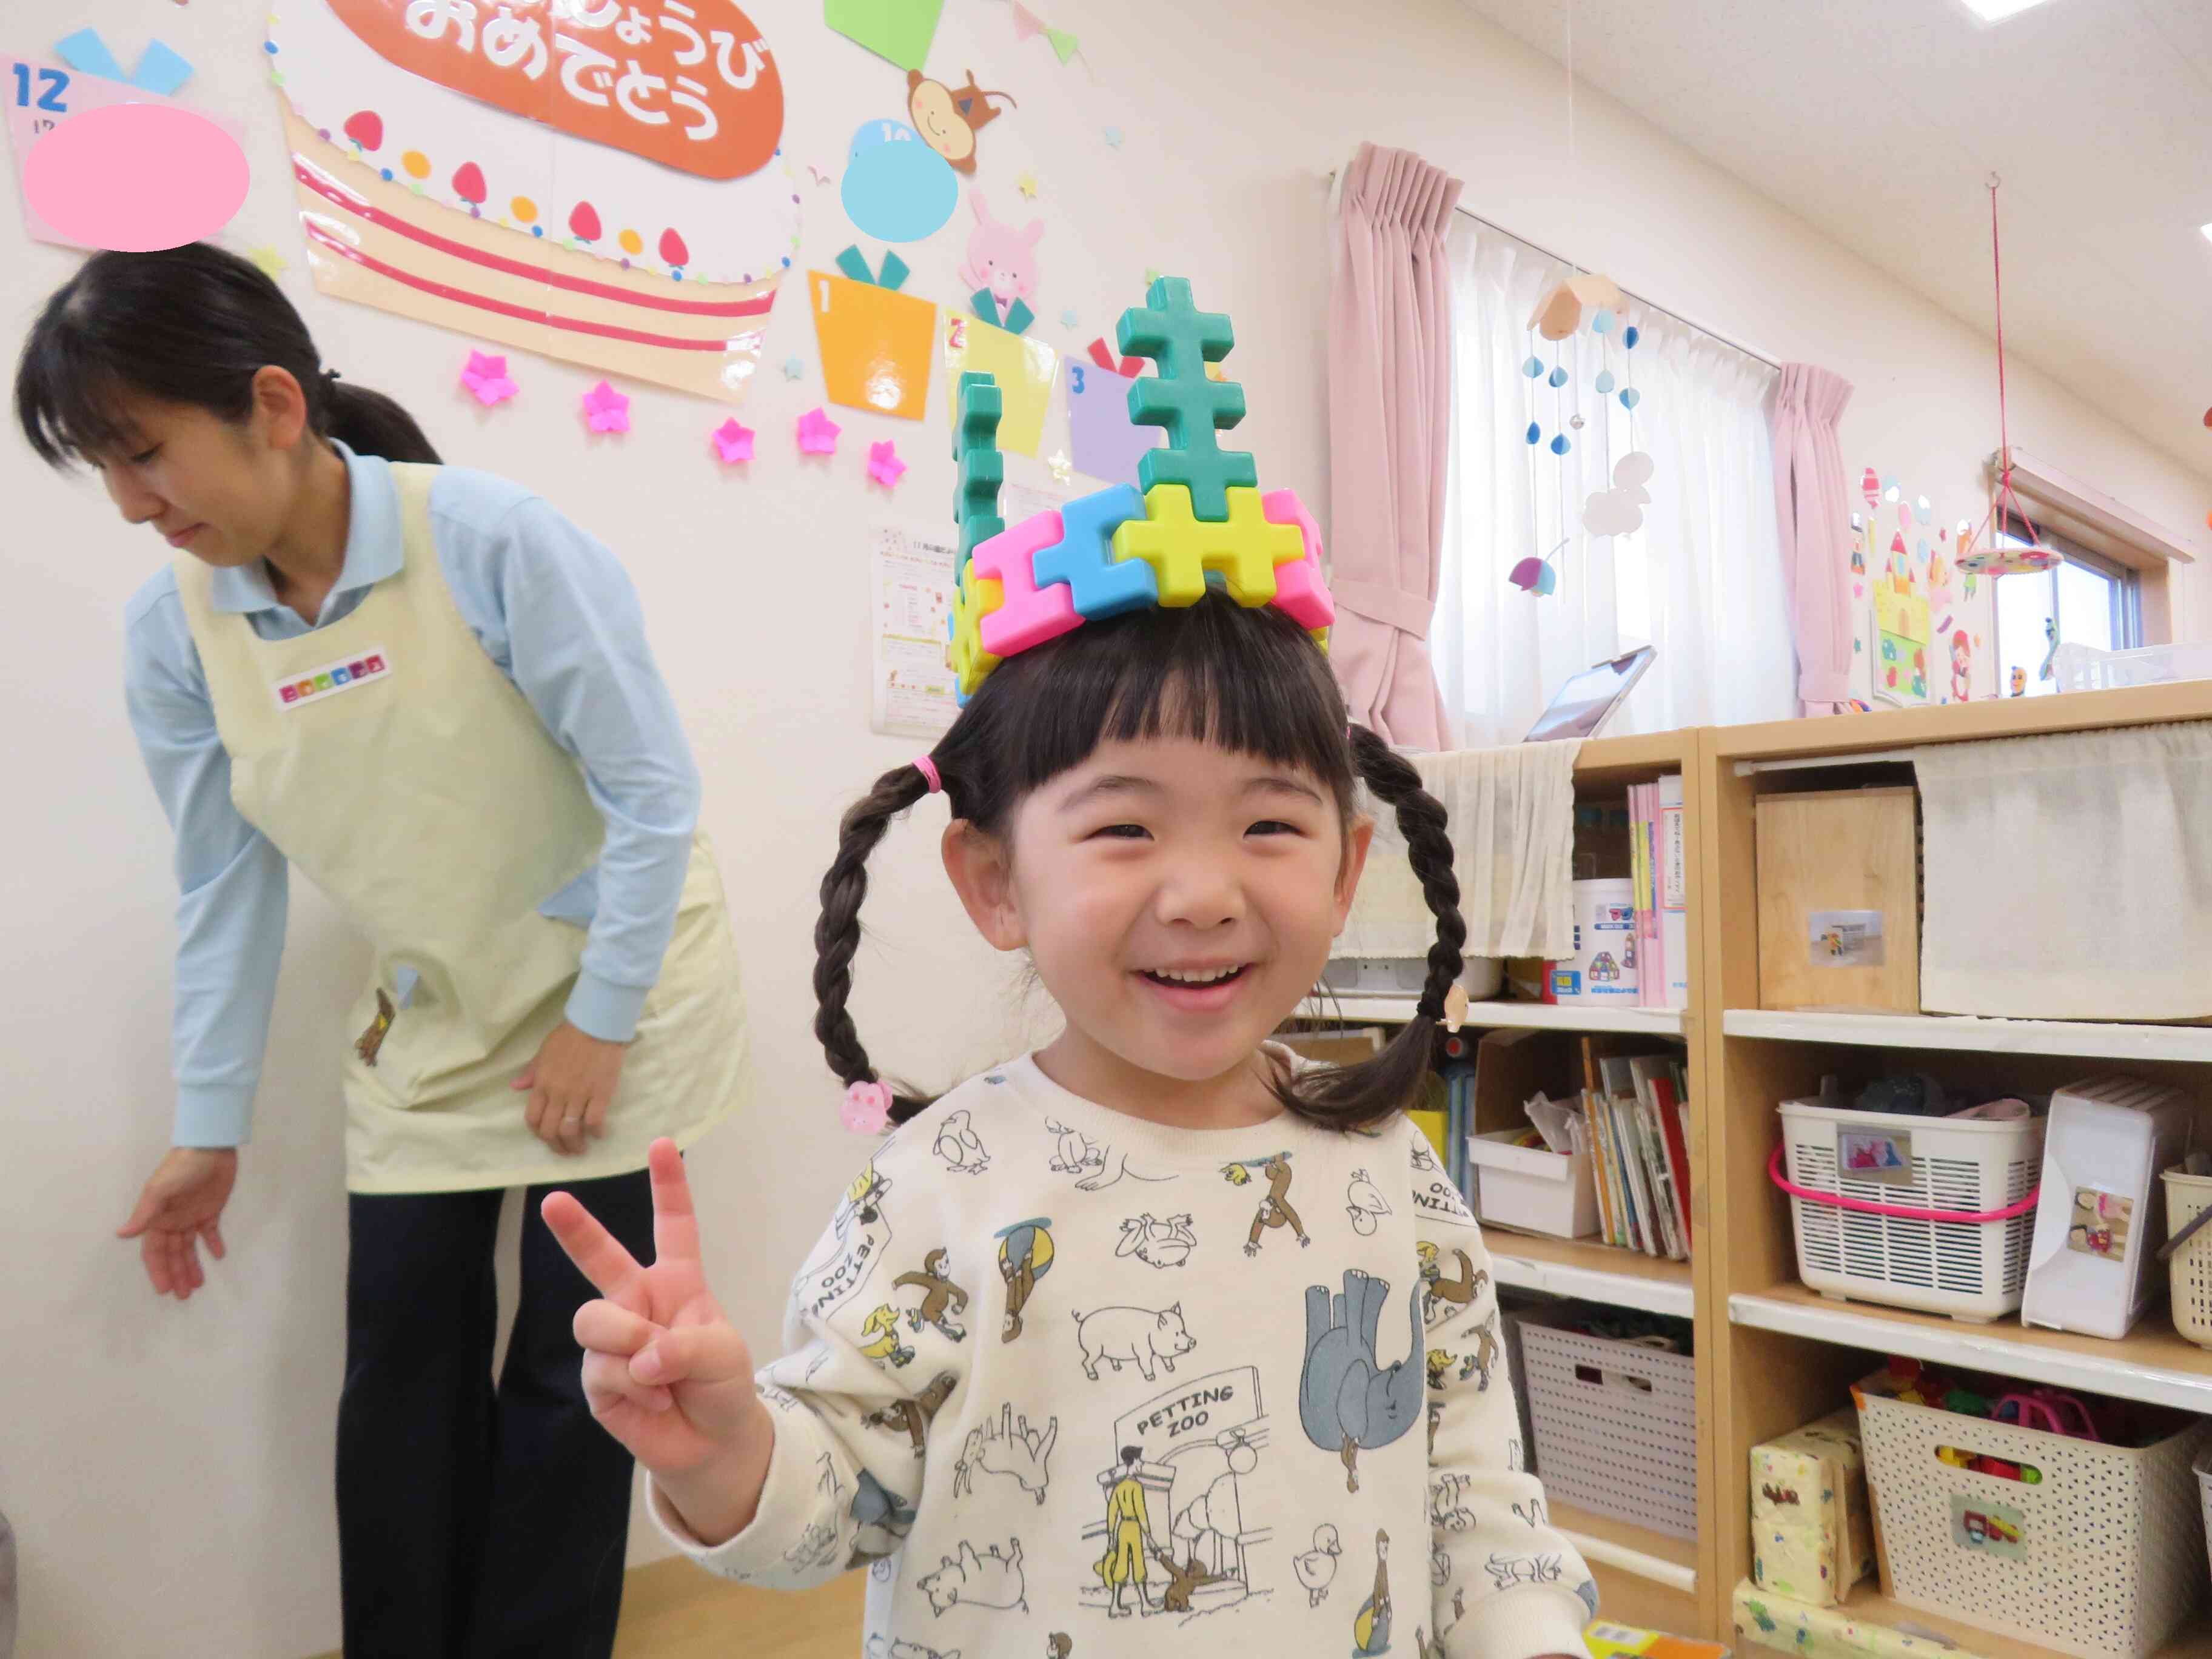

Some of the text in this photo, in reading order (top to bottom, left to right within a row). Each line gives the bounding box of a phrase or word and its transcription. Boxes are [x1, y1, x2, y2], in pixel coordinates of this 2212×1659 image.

[13, 62, 70, 112] 12
[405, 0, 719, 141] おめでとう
[819, 279, 830, 313] 1
[949, 318, 967, 348] 2
[1071, 366, 1085, 394] 3
[822, 1253, 853, 1287] ZOO
[1136, 1386, 1233, 1435] PETTING
[1167, 1411, 1208, 1438] ZOO
